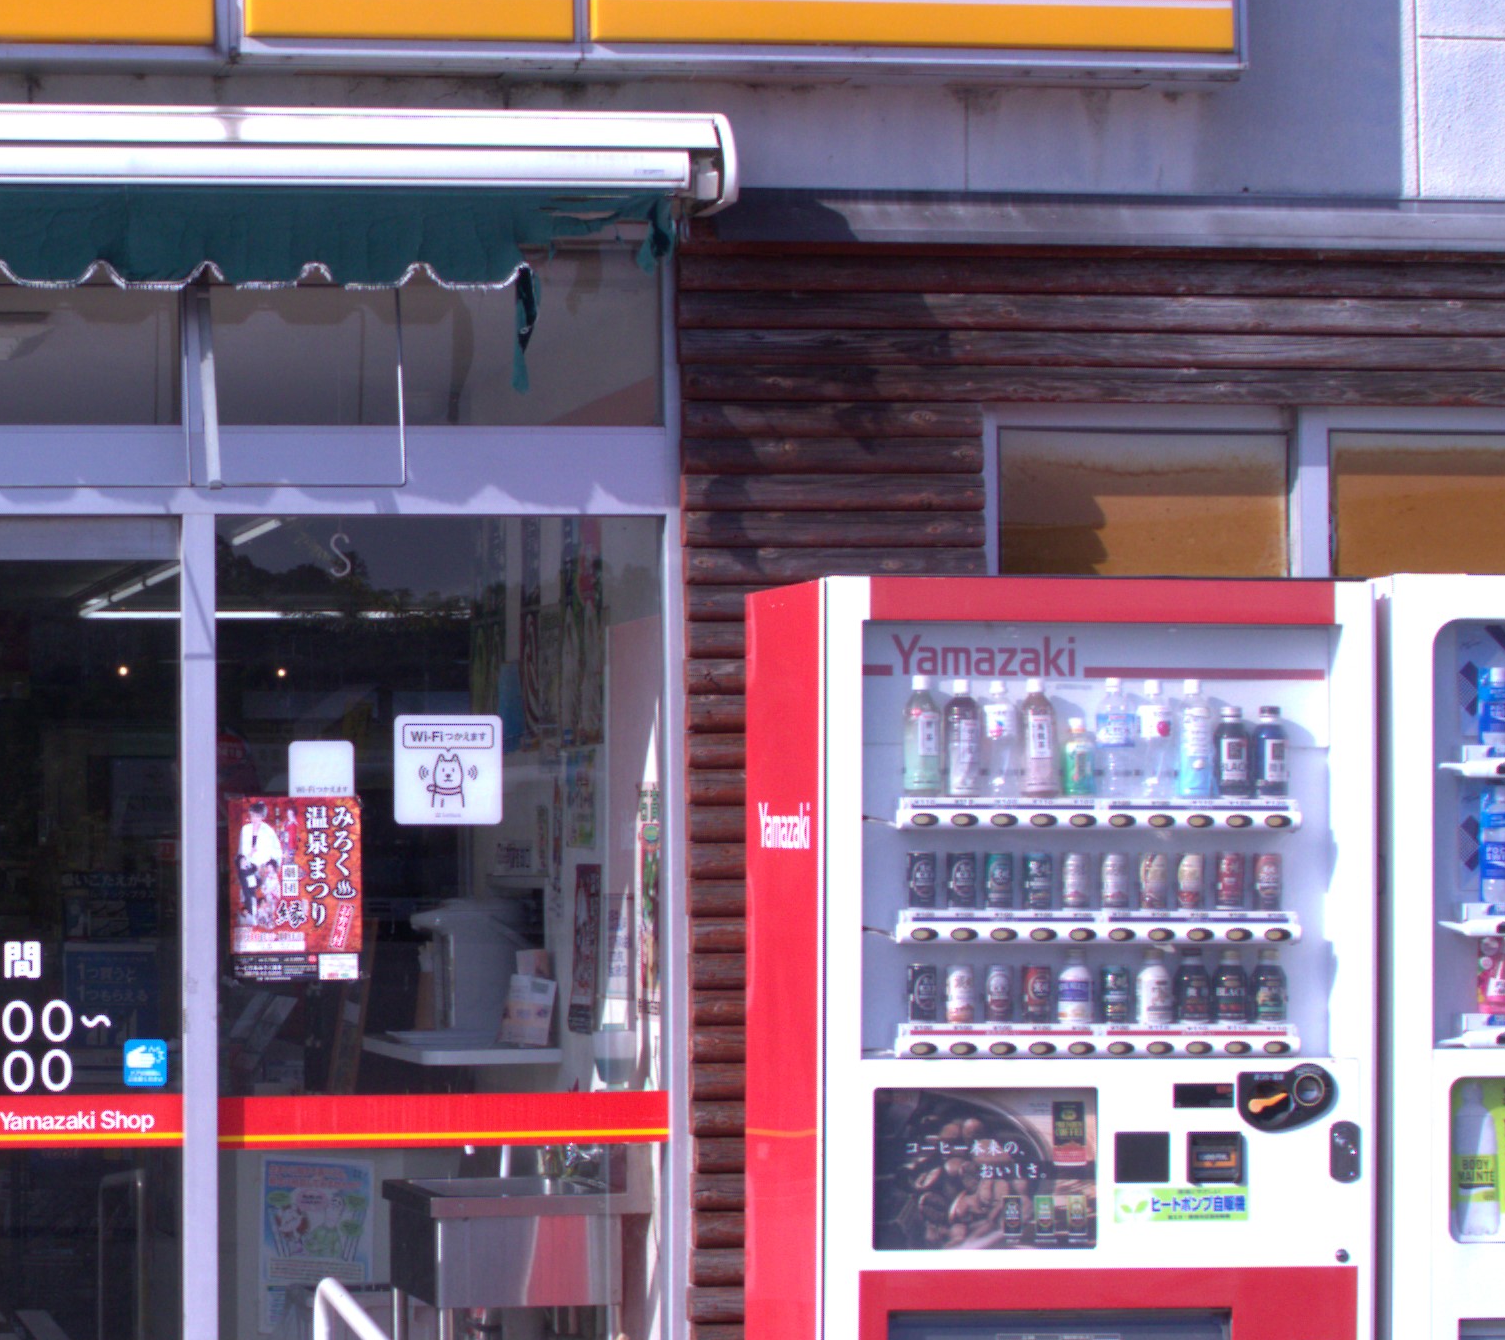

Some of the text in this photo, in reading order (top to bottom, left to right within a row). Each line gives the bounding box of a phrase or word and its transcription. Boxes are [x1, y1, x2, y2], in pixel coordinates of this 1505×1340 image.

[891, 634, 1076, 677] Yamazaki
[332, 805, 355, 877] みろく
[757, 801, 811, 850] Yamazaki
[305, 805, 331, 928] 温泉まつり
[0, 1109, 155, 1134] Yamazaki Shop
